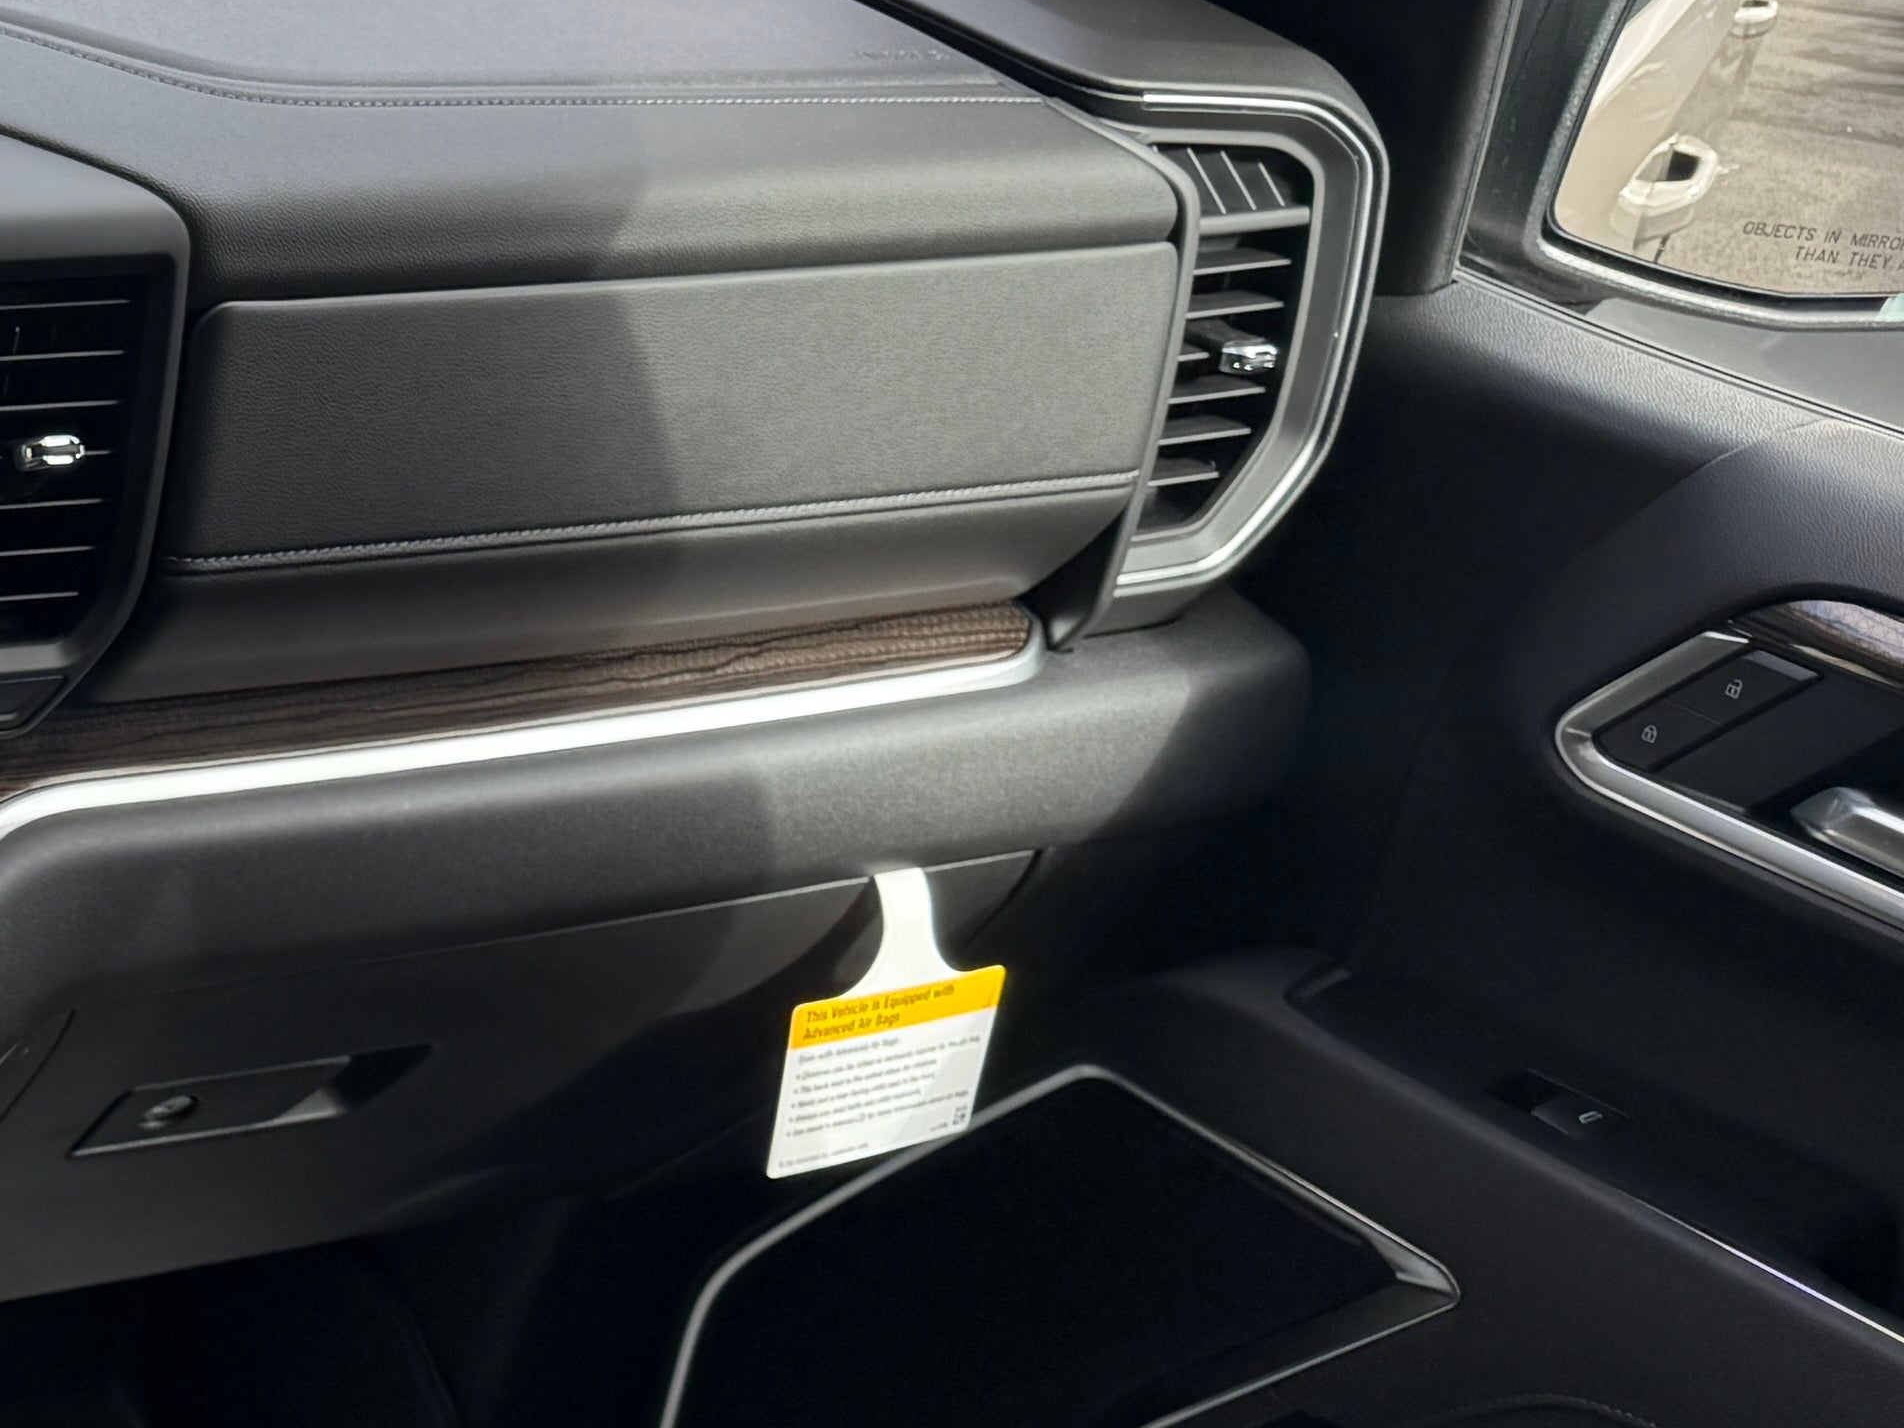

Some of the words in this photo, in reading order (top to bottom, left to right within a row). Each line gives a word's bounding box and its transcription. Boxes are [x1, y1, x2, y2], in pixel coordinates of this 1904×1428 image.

[1743, 222, 1817, 242] OBJECTS
[1824, 227, 1842, 244] IN
[1795, 246, 1841, 264] THAN
[1849, 251, 1893, 270] THEY
[807, 1009, 828, 1024] This
[832, 1001, 870, 1018] Vehicle
[883, 988, 932, 1010] Equipped
[933, 984, 955, 998] with
[802, 1020, 856, 1040] Advanced
[858, 1016, 873, 1029] Air
[875, 1012, 901, 1031] Bags
